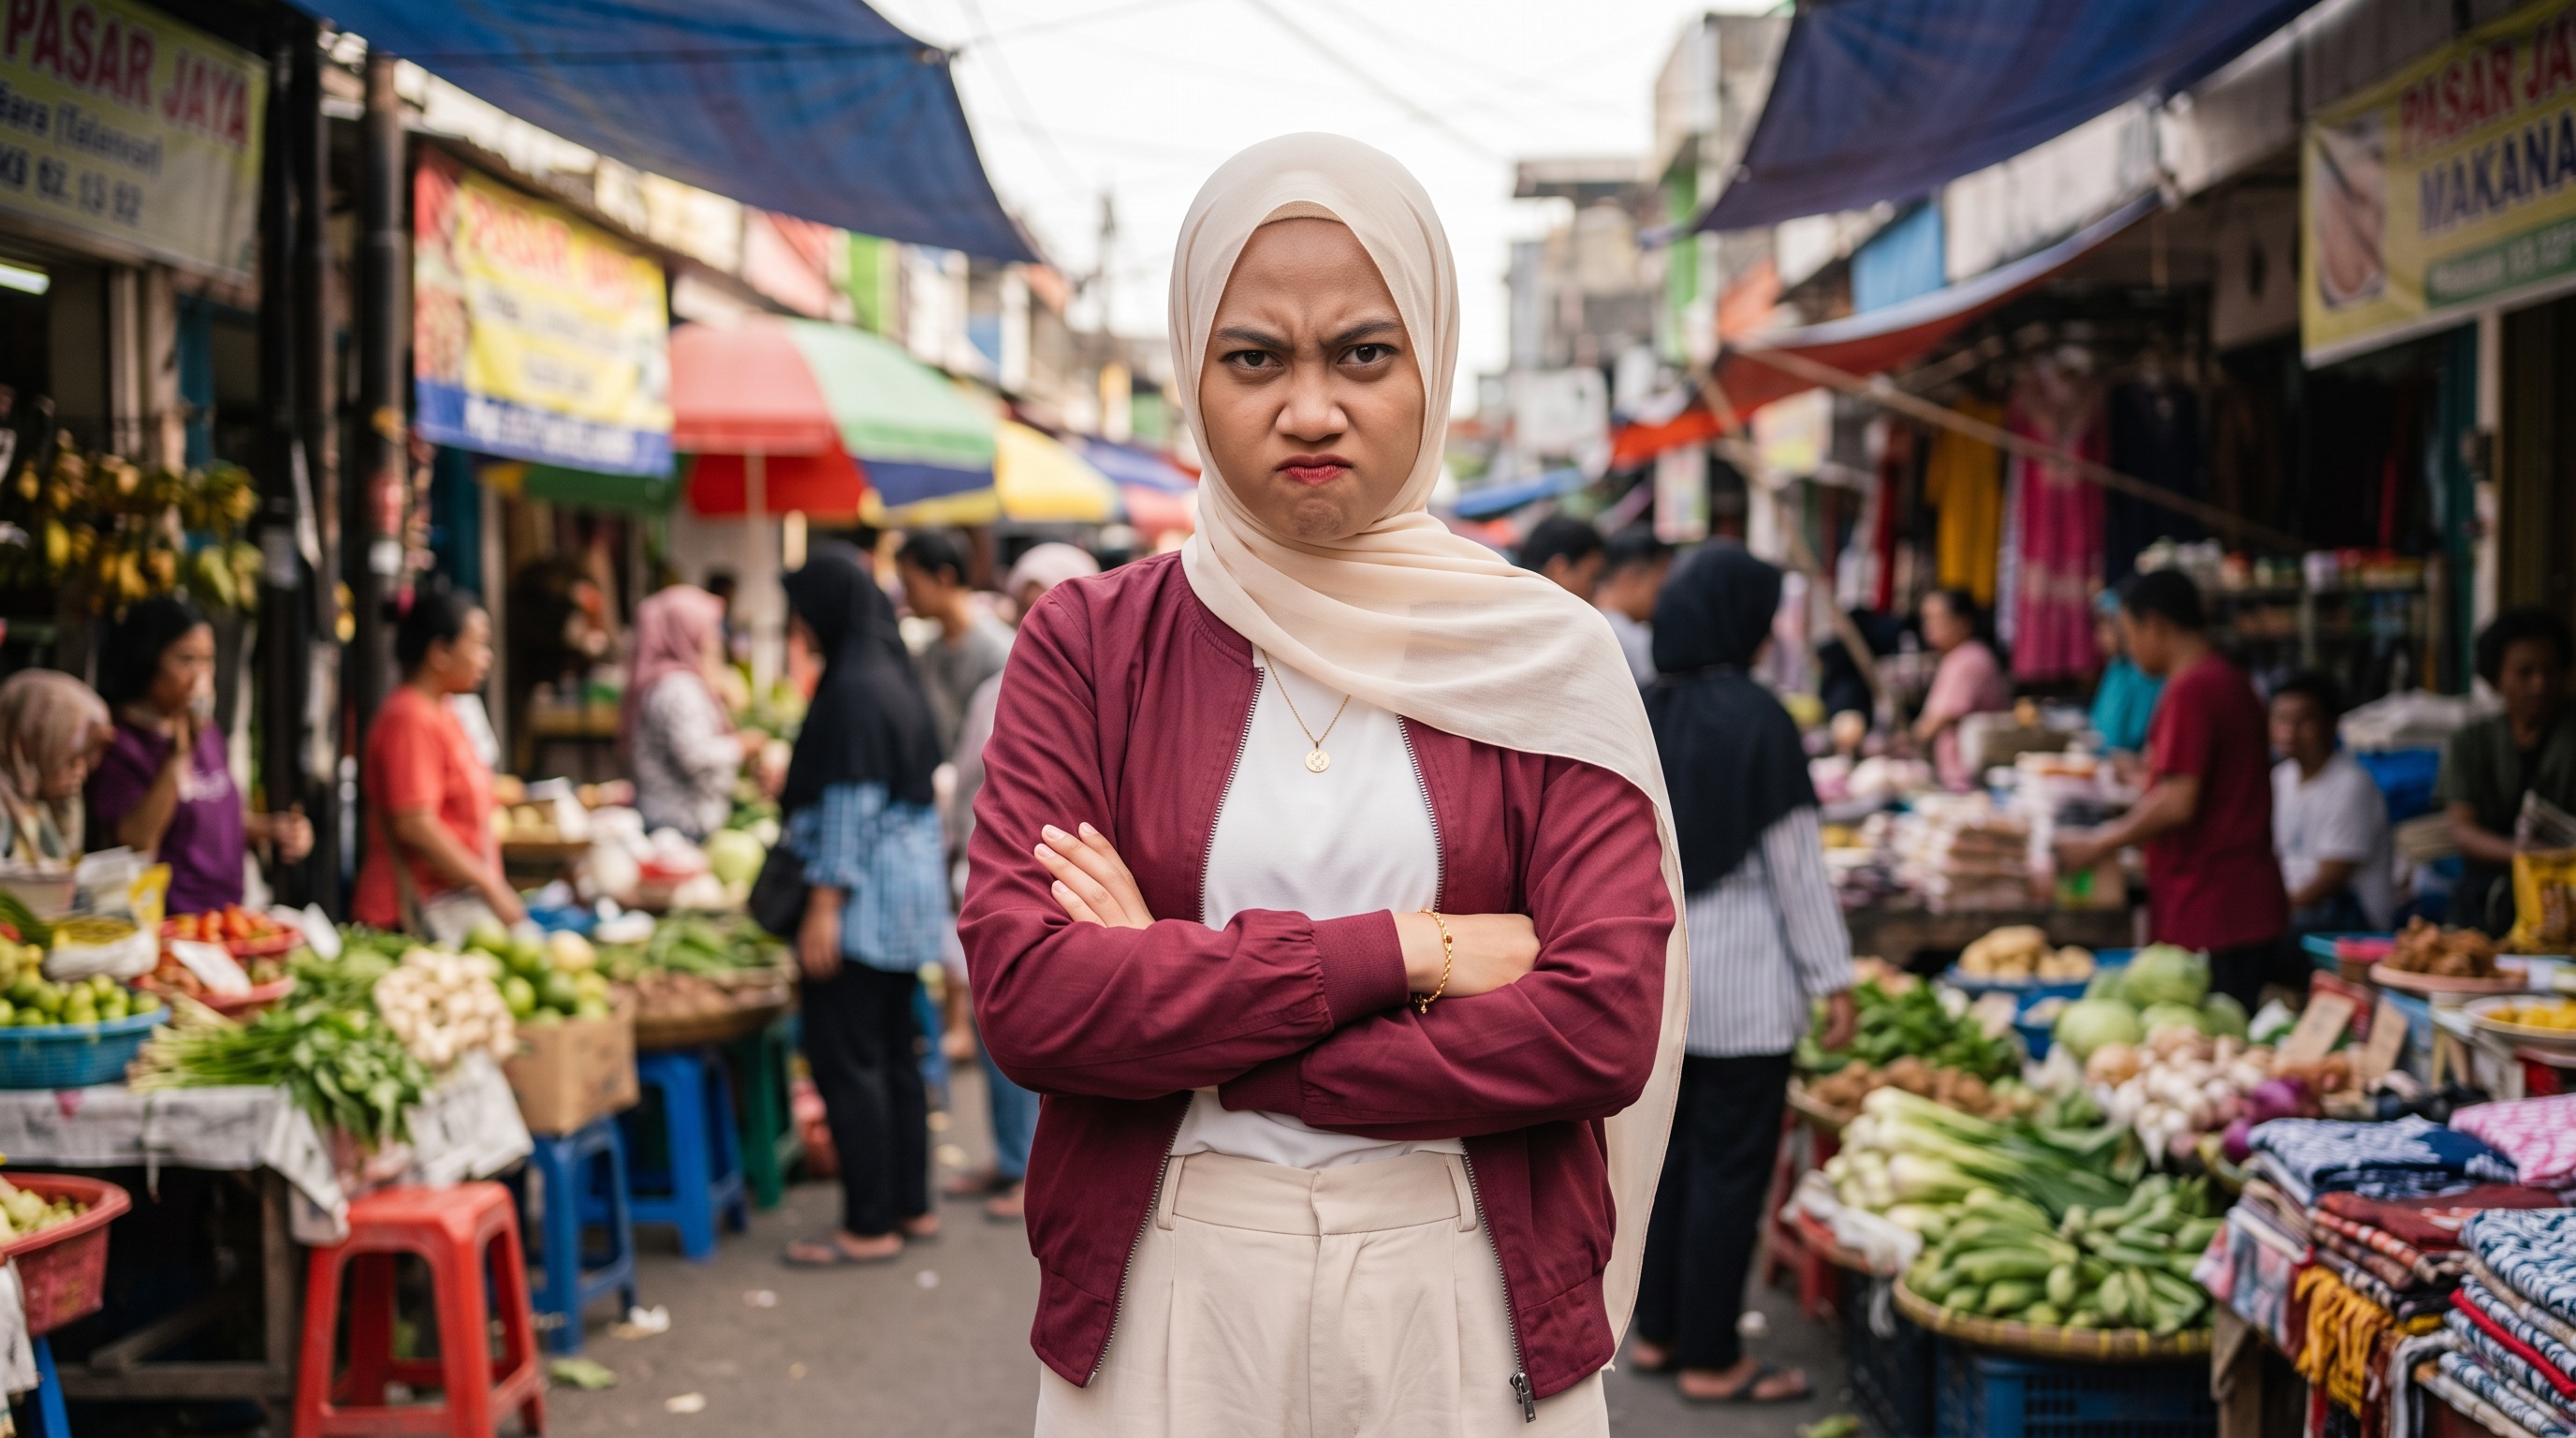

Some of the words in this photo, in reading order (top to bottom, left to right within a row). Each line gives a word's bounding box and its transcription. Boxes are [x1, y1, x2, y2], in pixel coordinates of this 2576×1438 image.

[6, 0, 154, 111] PASAR
[163, 51, 249, 151] JAYA
[2399, 42, 2516, 158] PASAR
[2525, 12, 2576, 100] JA
